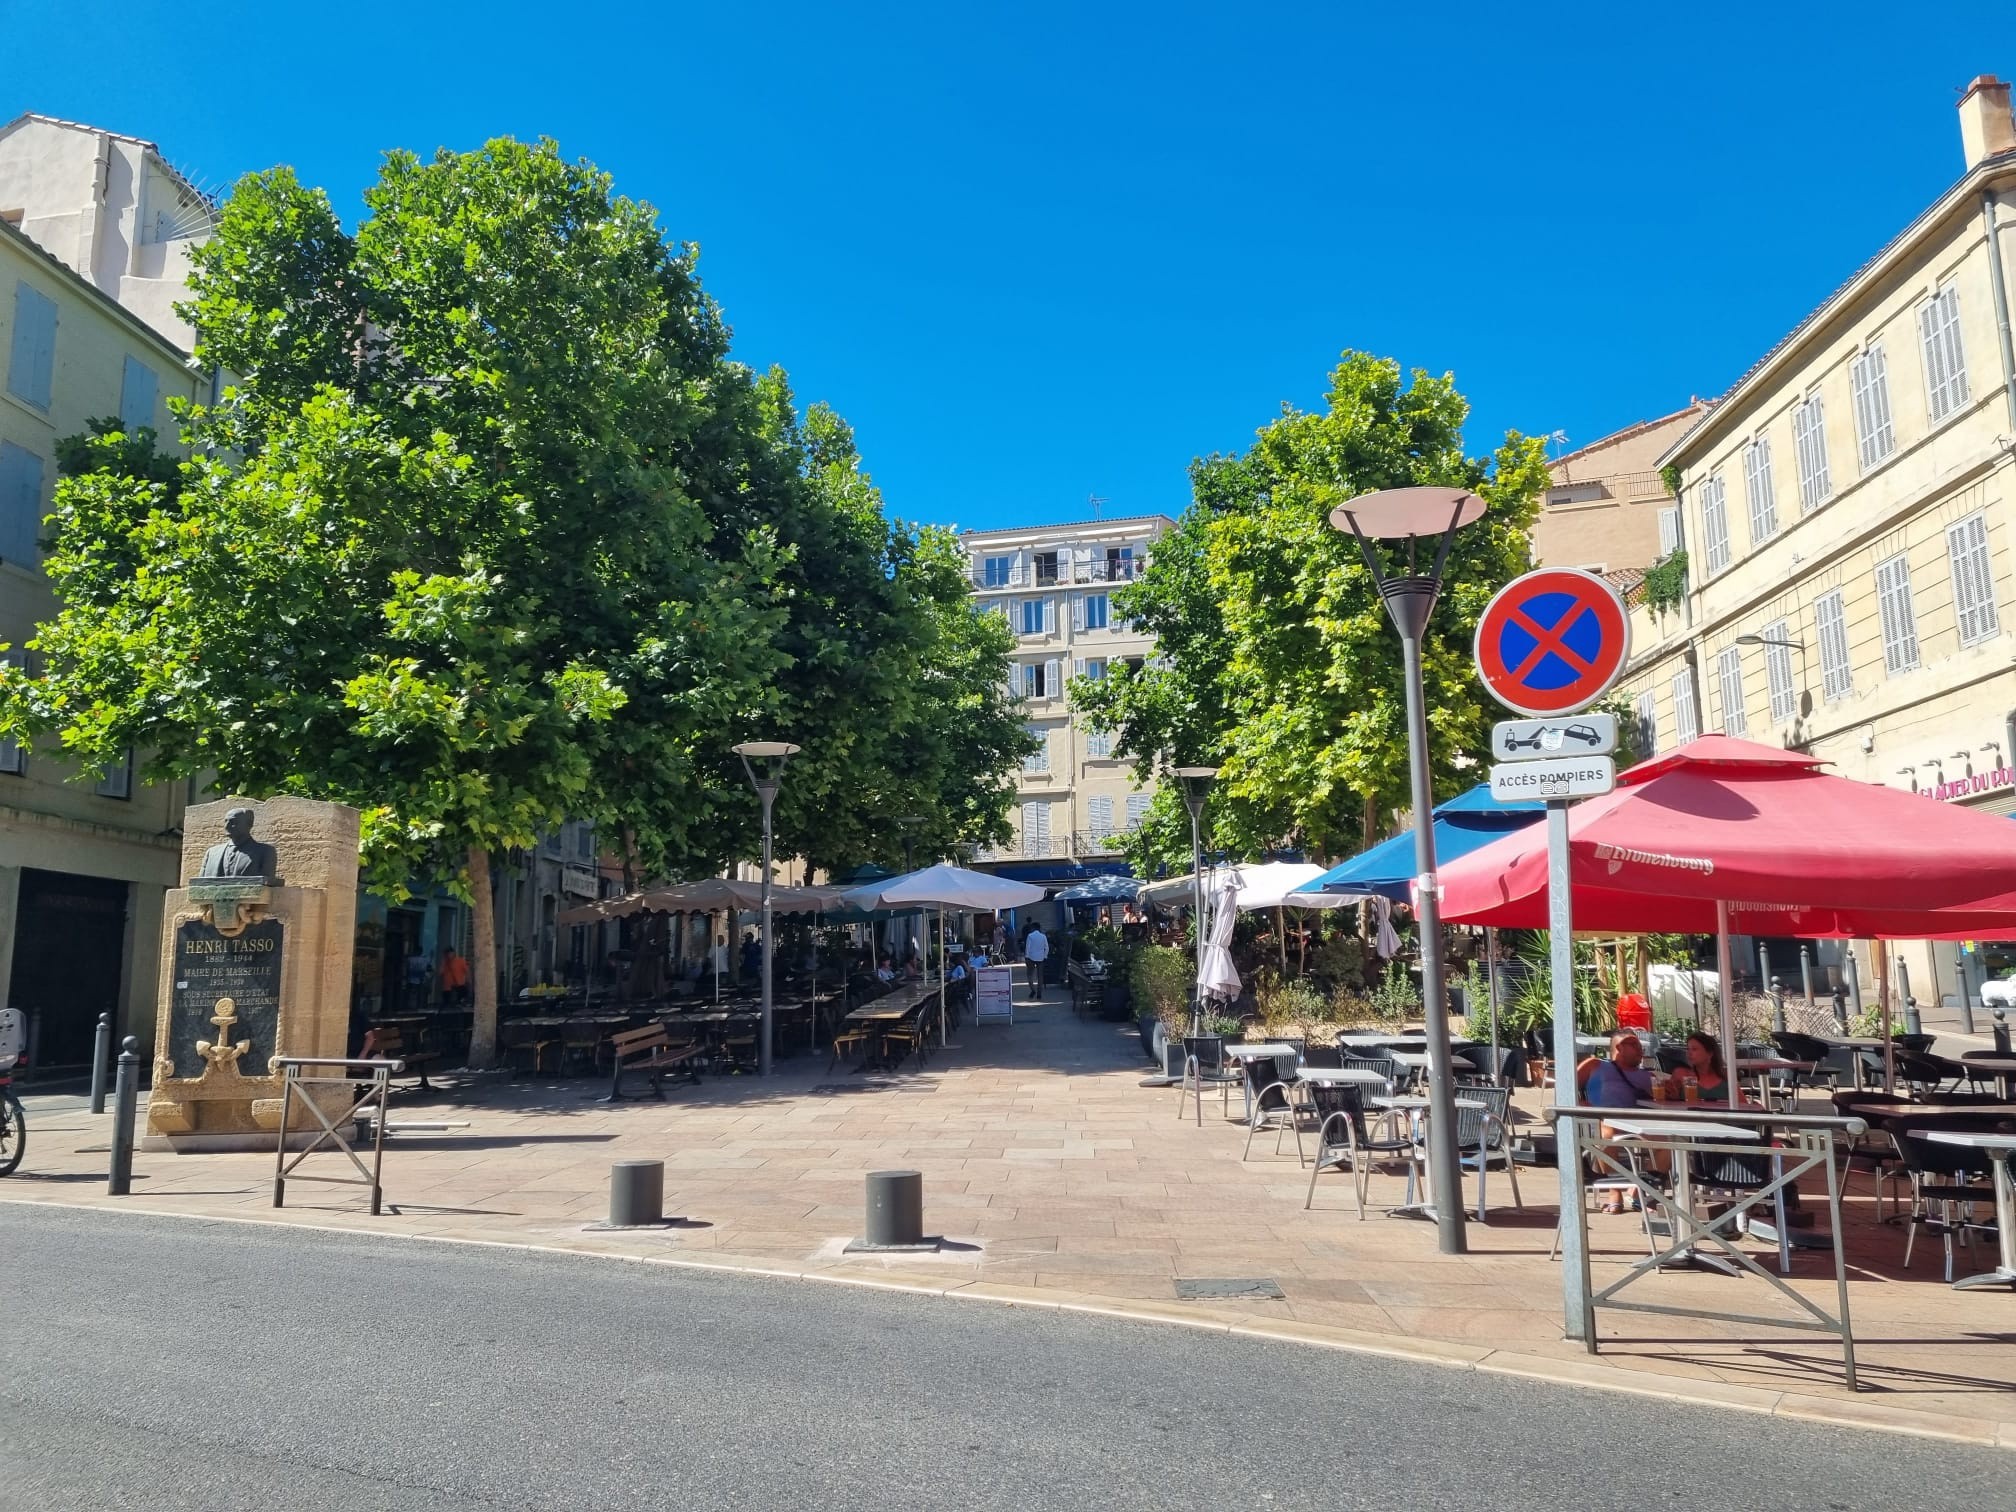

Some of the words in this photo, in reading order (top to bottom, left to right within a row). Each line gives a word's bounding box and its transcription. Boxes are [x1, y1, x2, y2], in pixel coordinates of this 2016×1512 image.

[1499, 774, 1537, 787] ACCÈS
[1539, 769, 1604, 785] POMPIERS
[1972, 772, 1989, 793] DU
[185, 940, 228, 954] HENRI
[232, 939, 274, 953] TASSO
[184, 968, 210, 977] MAIRE
[212, 967, 225, 976] DE
[225, 966, 272, 976] MARSEILLE
